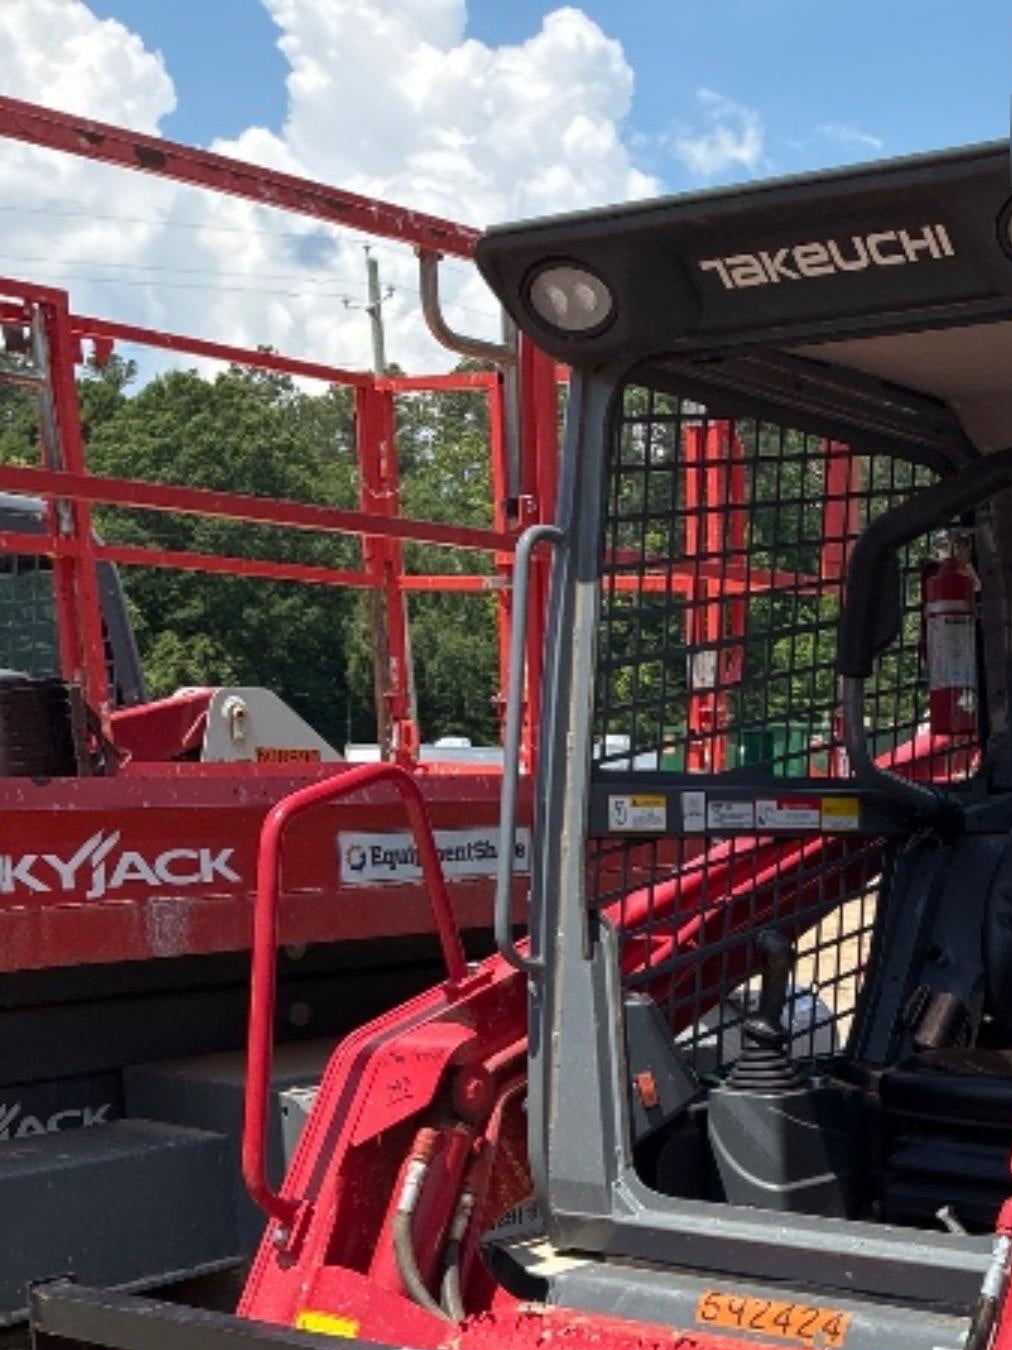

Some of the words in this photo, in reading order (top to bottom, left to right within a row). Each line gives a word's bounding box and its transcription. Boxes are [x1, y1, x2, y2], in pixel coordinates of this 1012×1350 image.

[0, 828, 242, 900] KYJACK
[370, 839, 526, 870] EquientShe
[701, 1292, 844, 1342] 542424
